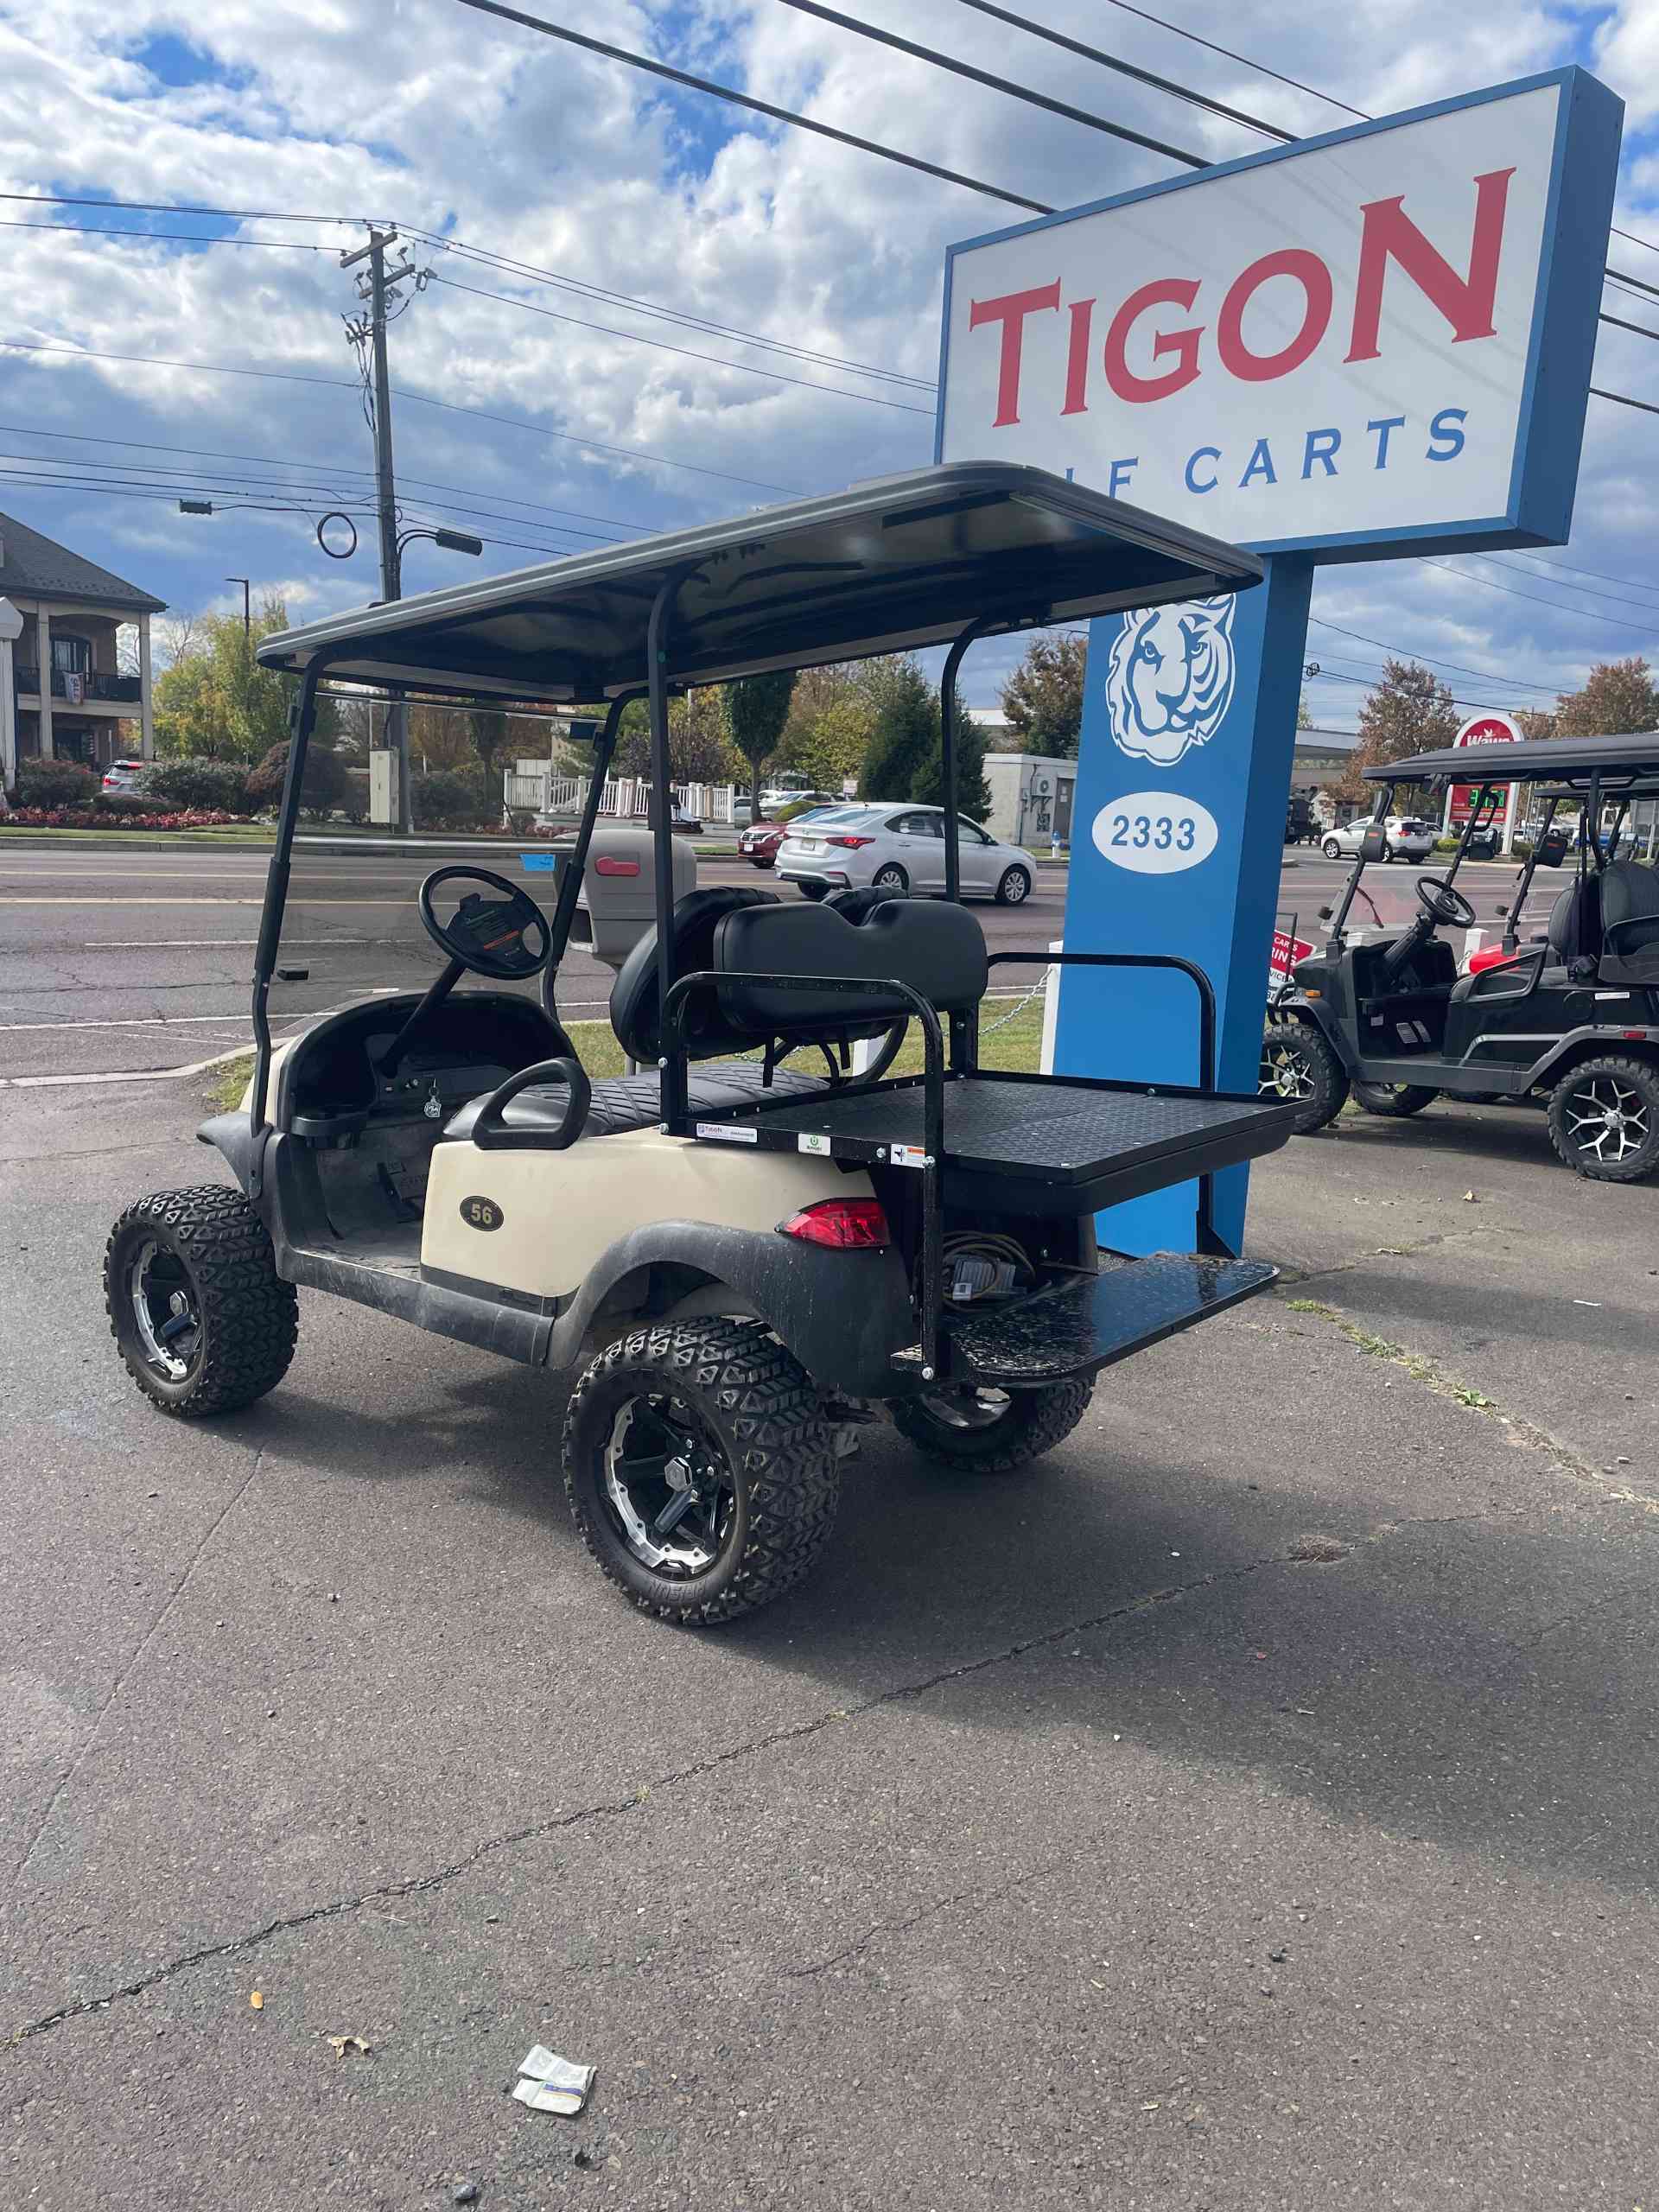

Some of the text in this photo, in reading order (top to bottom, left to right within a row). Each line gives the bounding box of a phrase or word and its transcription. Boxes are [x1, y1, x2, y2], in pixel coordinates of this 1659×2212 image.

[969, 166, 1516, 428] TIGON
[1185, 408, 1468, 493] CARTS
[1111, 815, 1196, 851] 2333
[470, 1203, 493, 1224] 56
